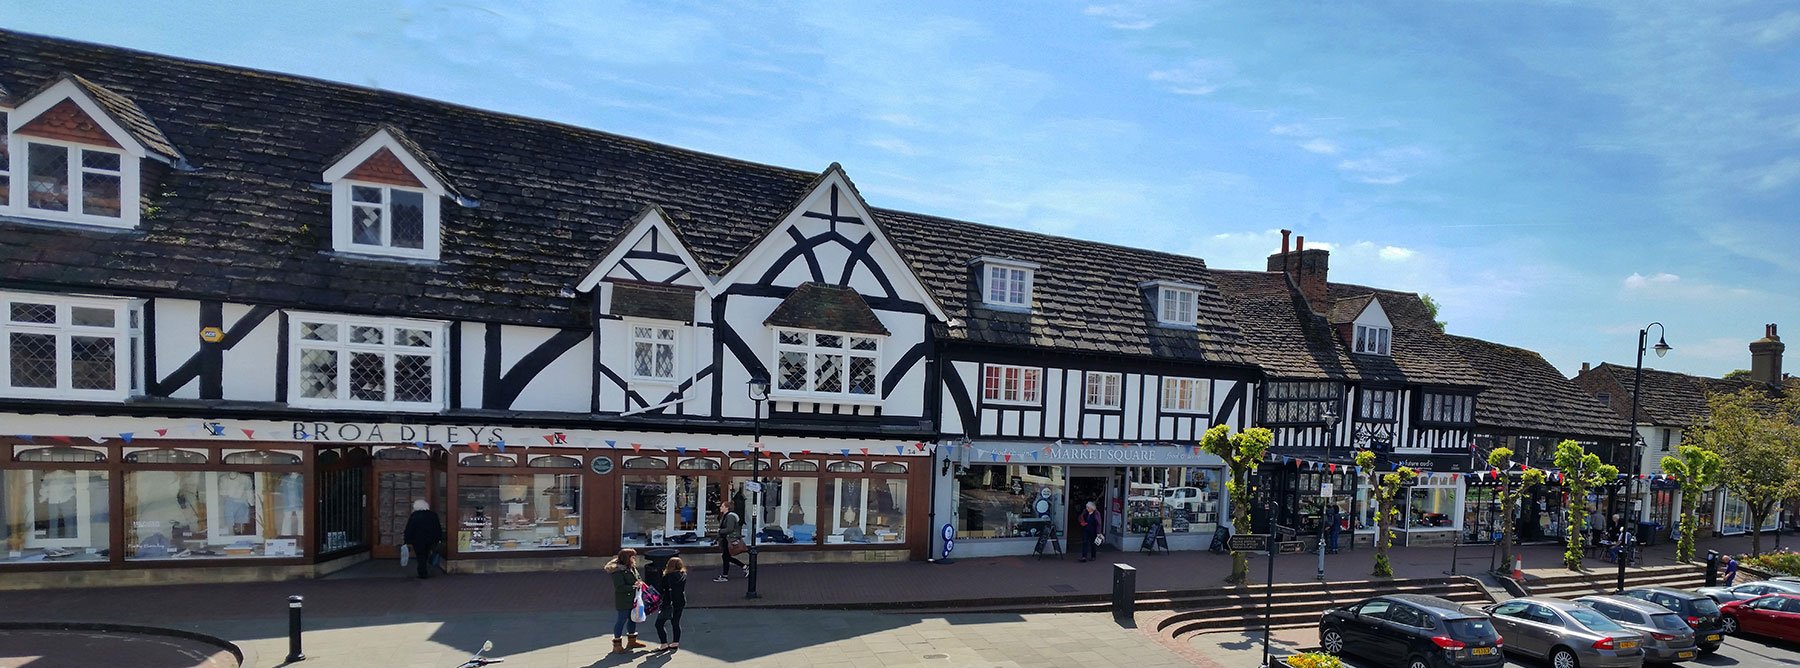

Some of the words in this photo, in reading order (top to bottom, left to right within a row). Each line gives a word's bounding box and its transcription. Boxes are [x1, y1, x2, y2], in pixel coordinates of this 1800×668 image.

[293, 422, 503, 443] BROADLEYS
[1050, 448, 1105, 460] MARKET
[1107, 449, 1155, 463] SQUARE
